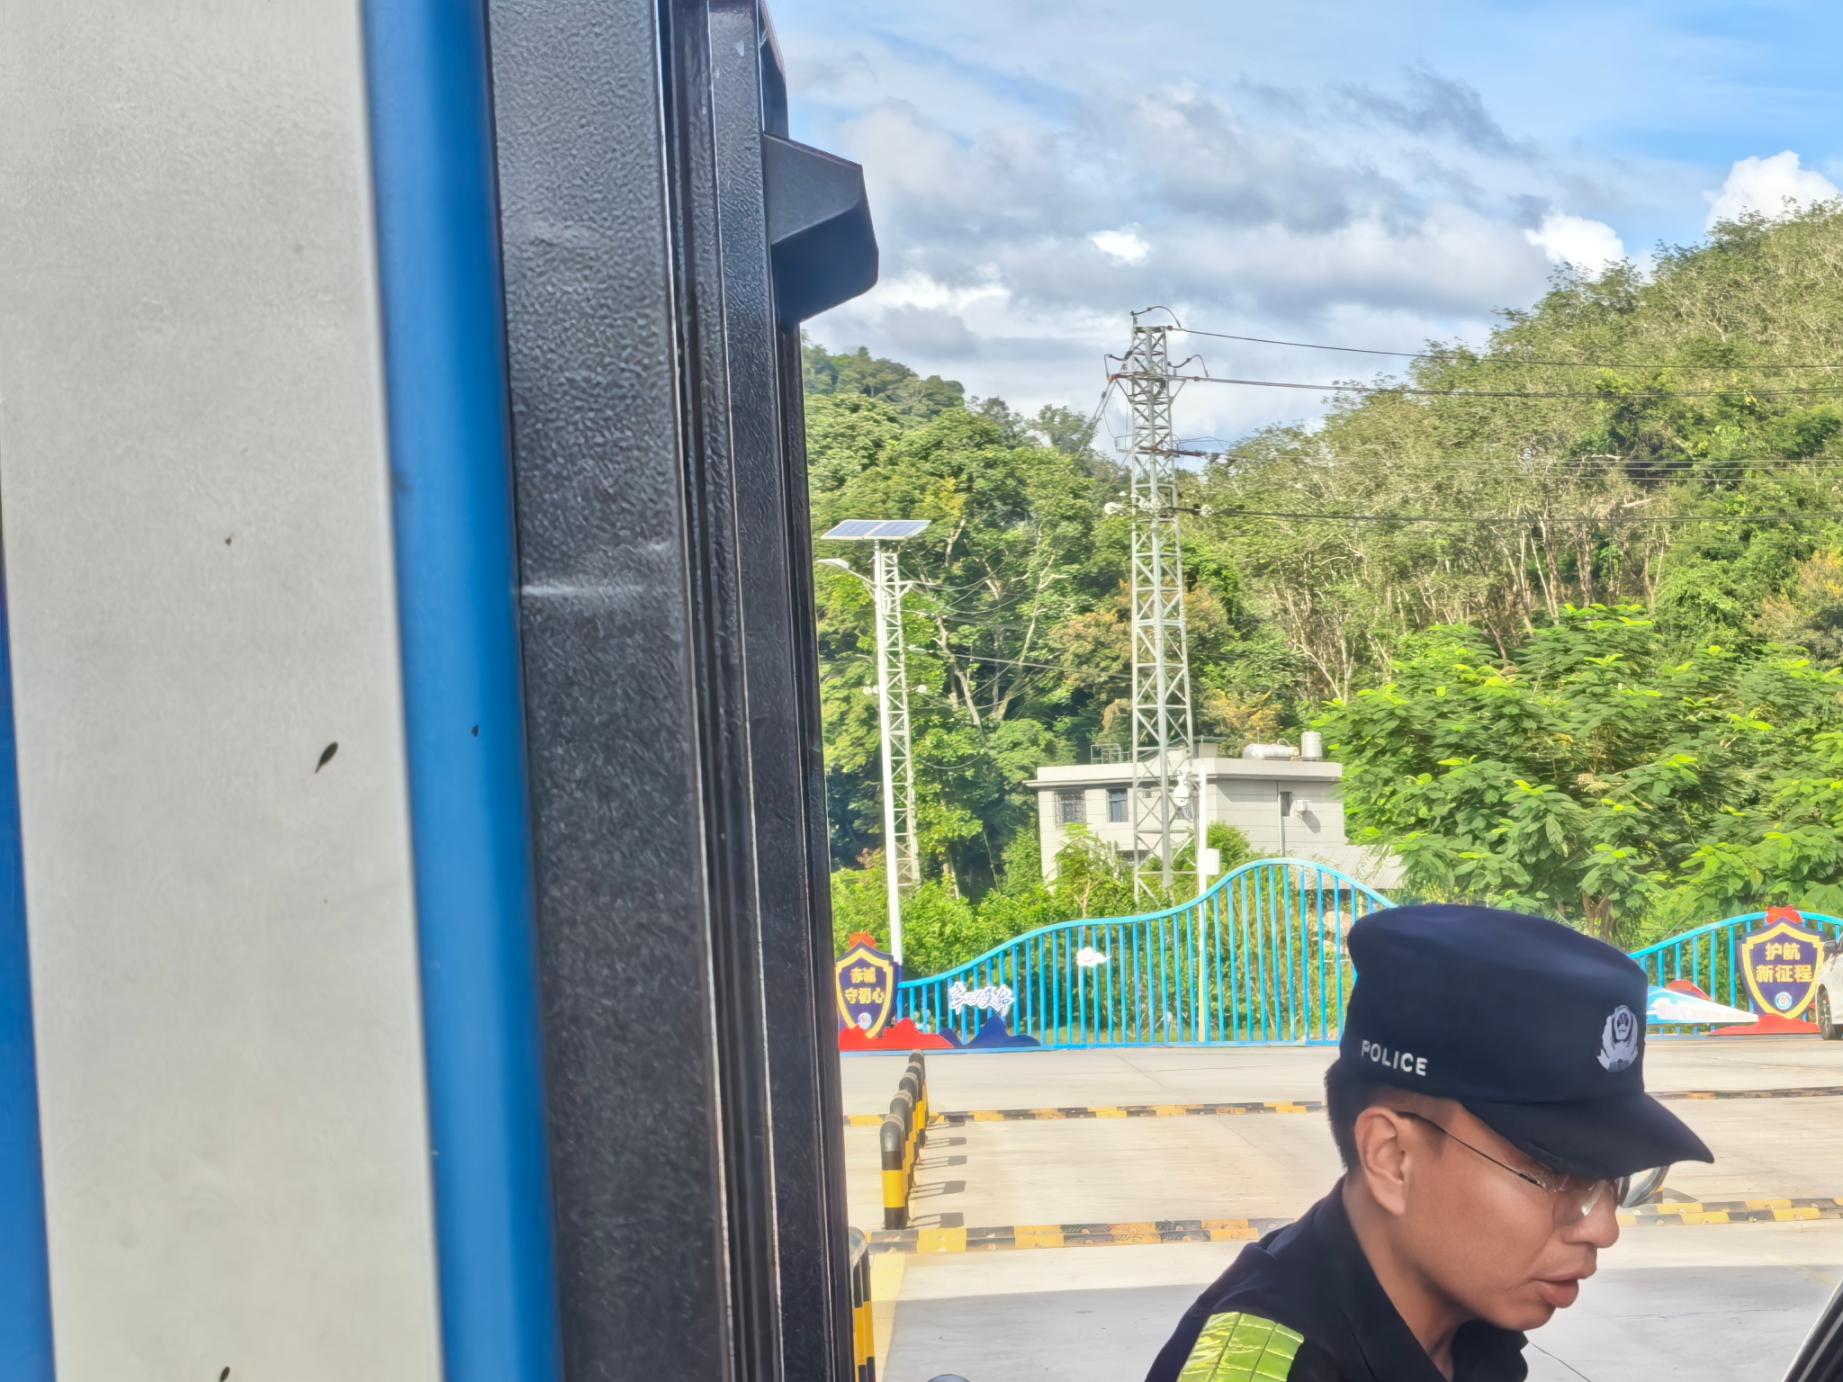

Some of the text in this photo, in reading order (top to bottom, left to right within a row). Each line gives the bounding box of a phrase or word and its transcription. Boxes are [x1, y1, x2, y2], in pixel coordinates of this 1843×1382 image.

[1765, 942, 1801, 961] 护航
[1756, 964, 1813, 983] 新征程
[844, 986, 885, 1005] 守初心
[1360, 1039, 1428, 1077] POLICE
